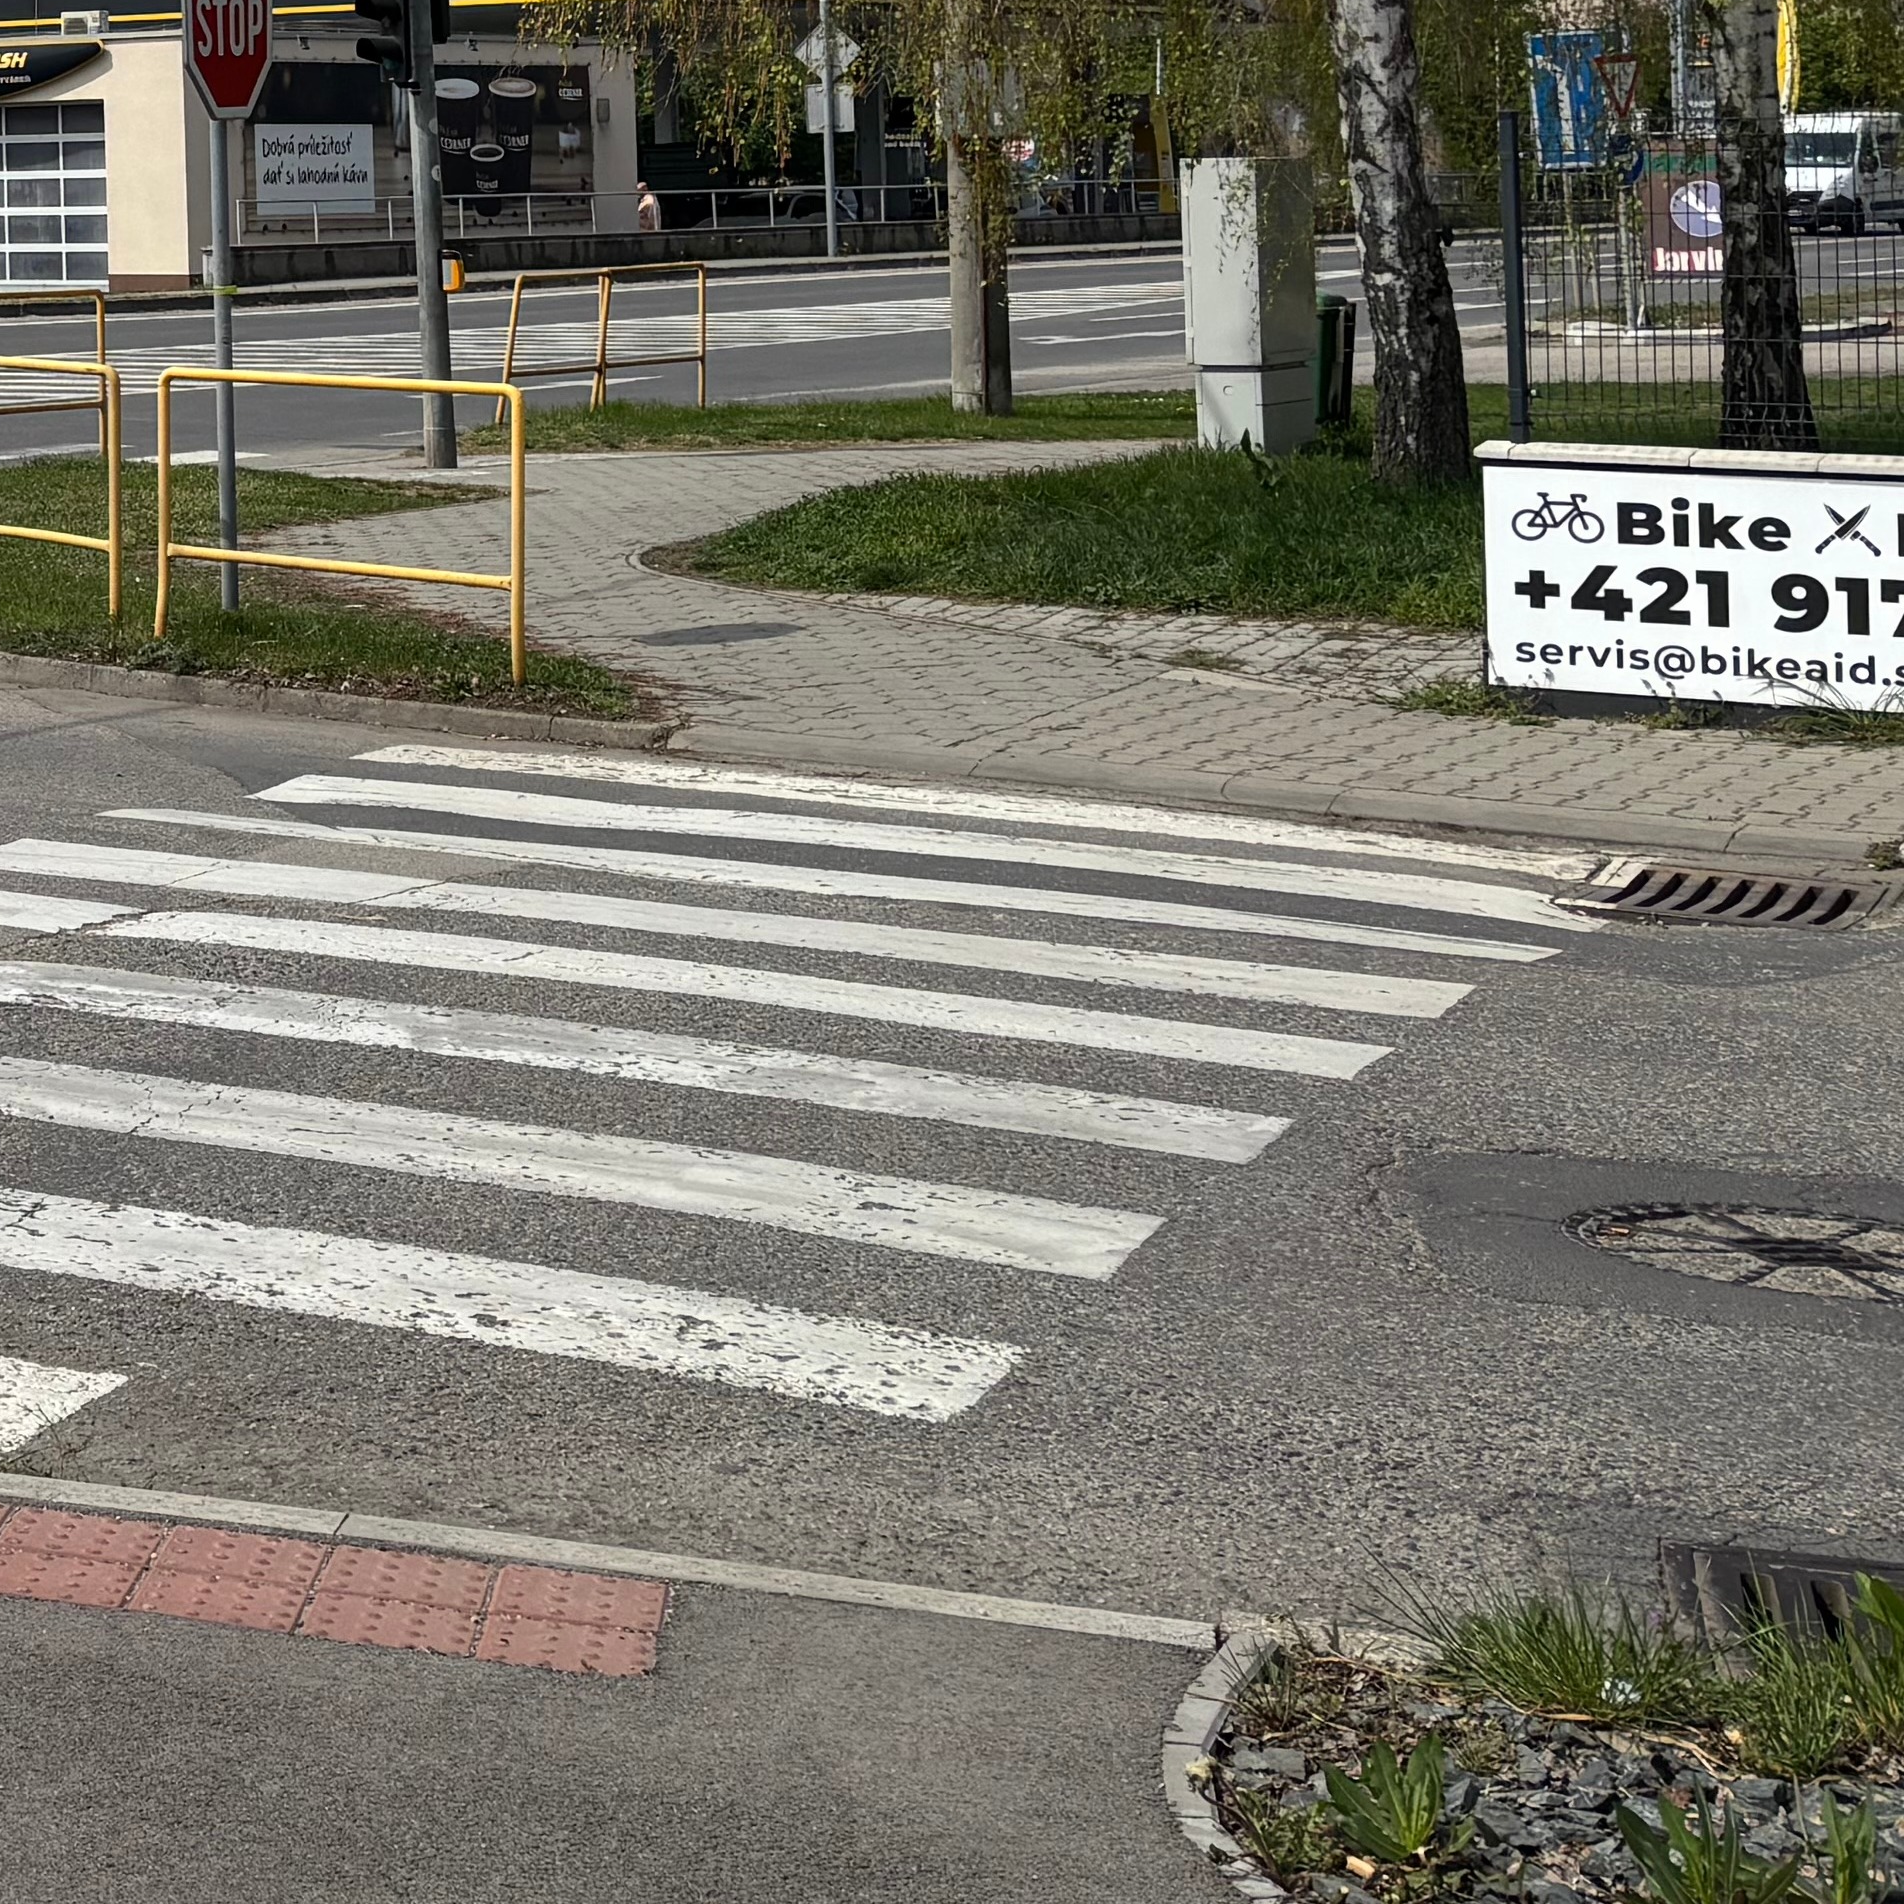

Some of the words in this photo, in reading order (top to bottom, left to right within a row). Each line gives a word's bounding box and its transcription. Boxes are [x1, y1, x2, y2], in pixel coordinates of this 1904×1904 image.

[262, 134, 295, 158] Dobrá
[297, 131, 353, 159] príležitosť
[263, 160, 284, 185] dať
[286, 165, 295, 185] si
[1617, 497, 1792, 552] Bike
[1514, 565, 1731, 628] +421
